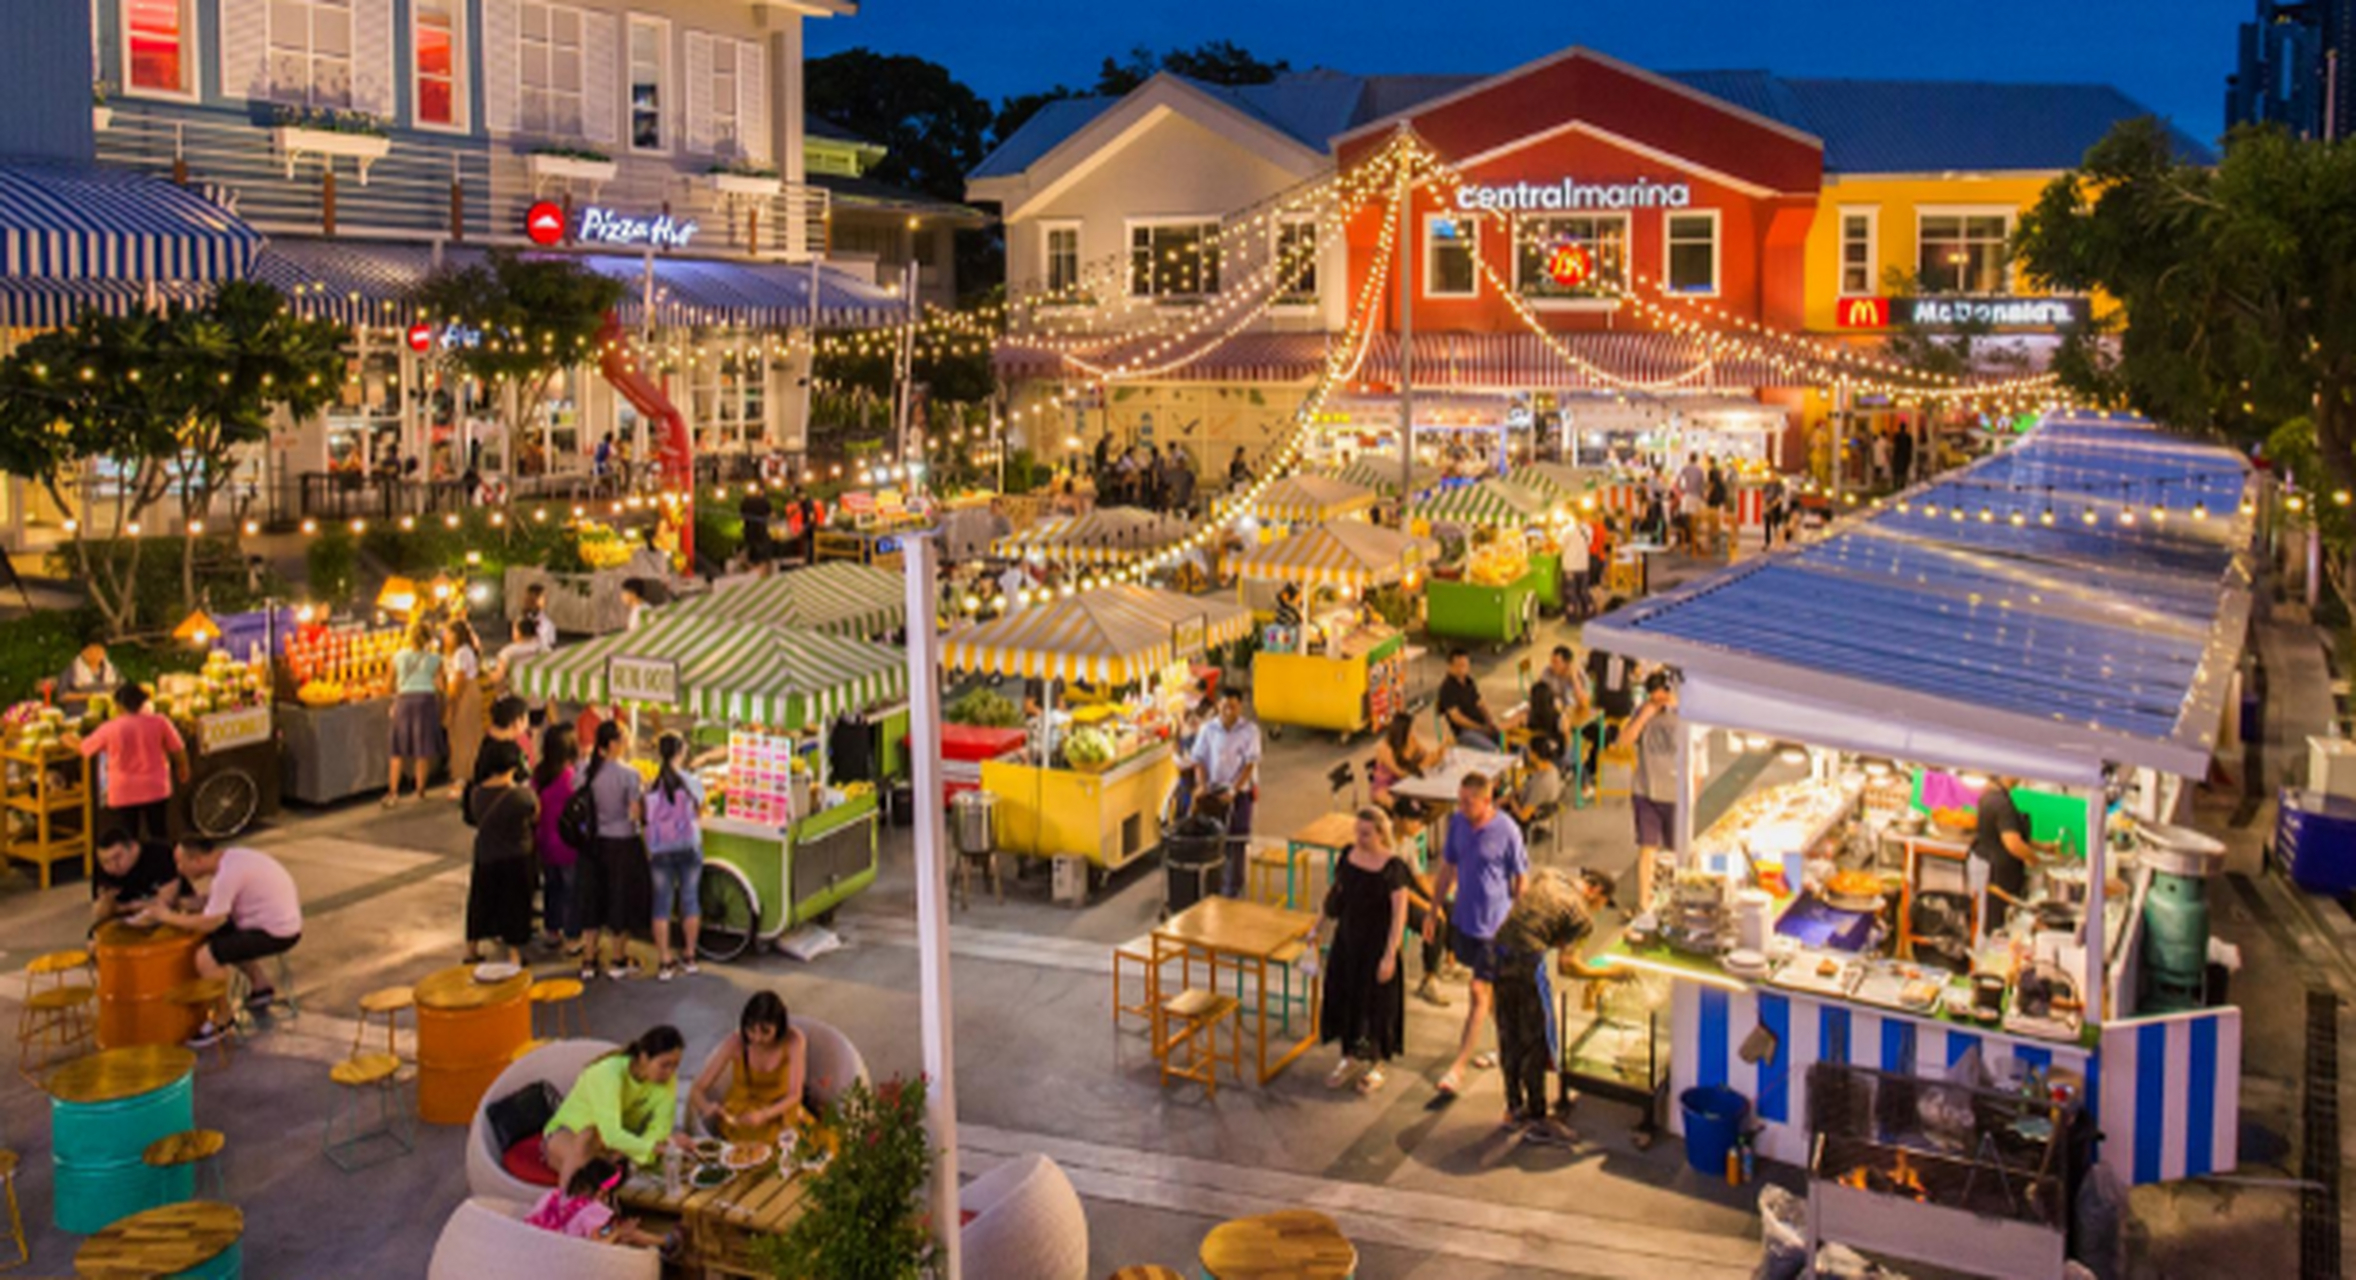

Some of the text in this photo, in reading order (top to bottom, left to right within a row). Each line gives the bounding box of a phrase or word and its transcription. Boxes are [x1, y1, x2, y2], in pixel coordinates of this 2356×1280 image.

[1456, 177, 1690, 208] centralmarina
[579, 207, 699, 247] Pizza Hut
[1912, 300, 2074, 324] McDonald's
